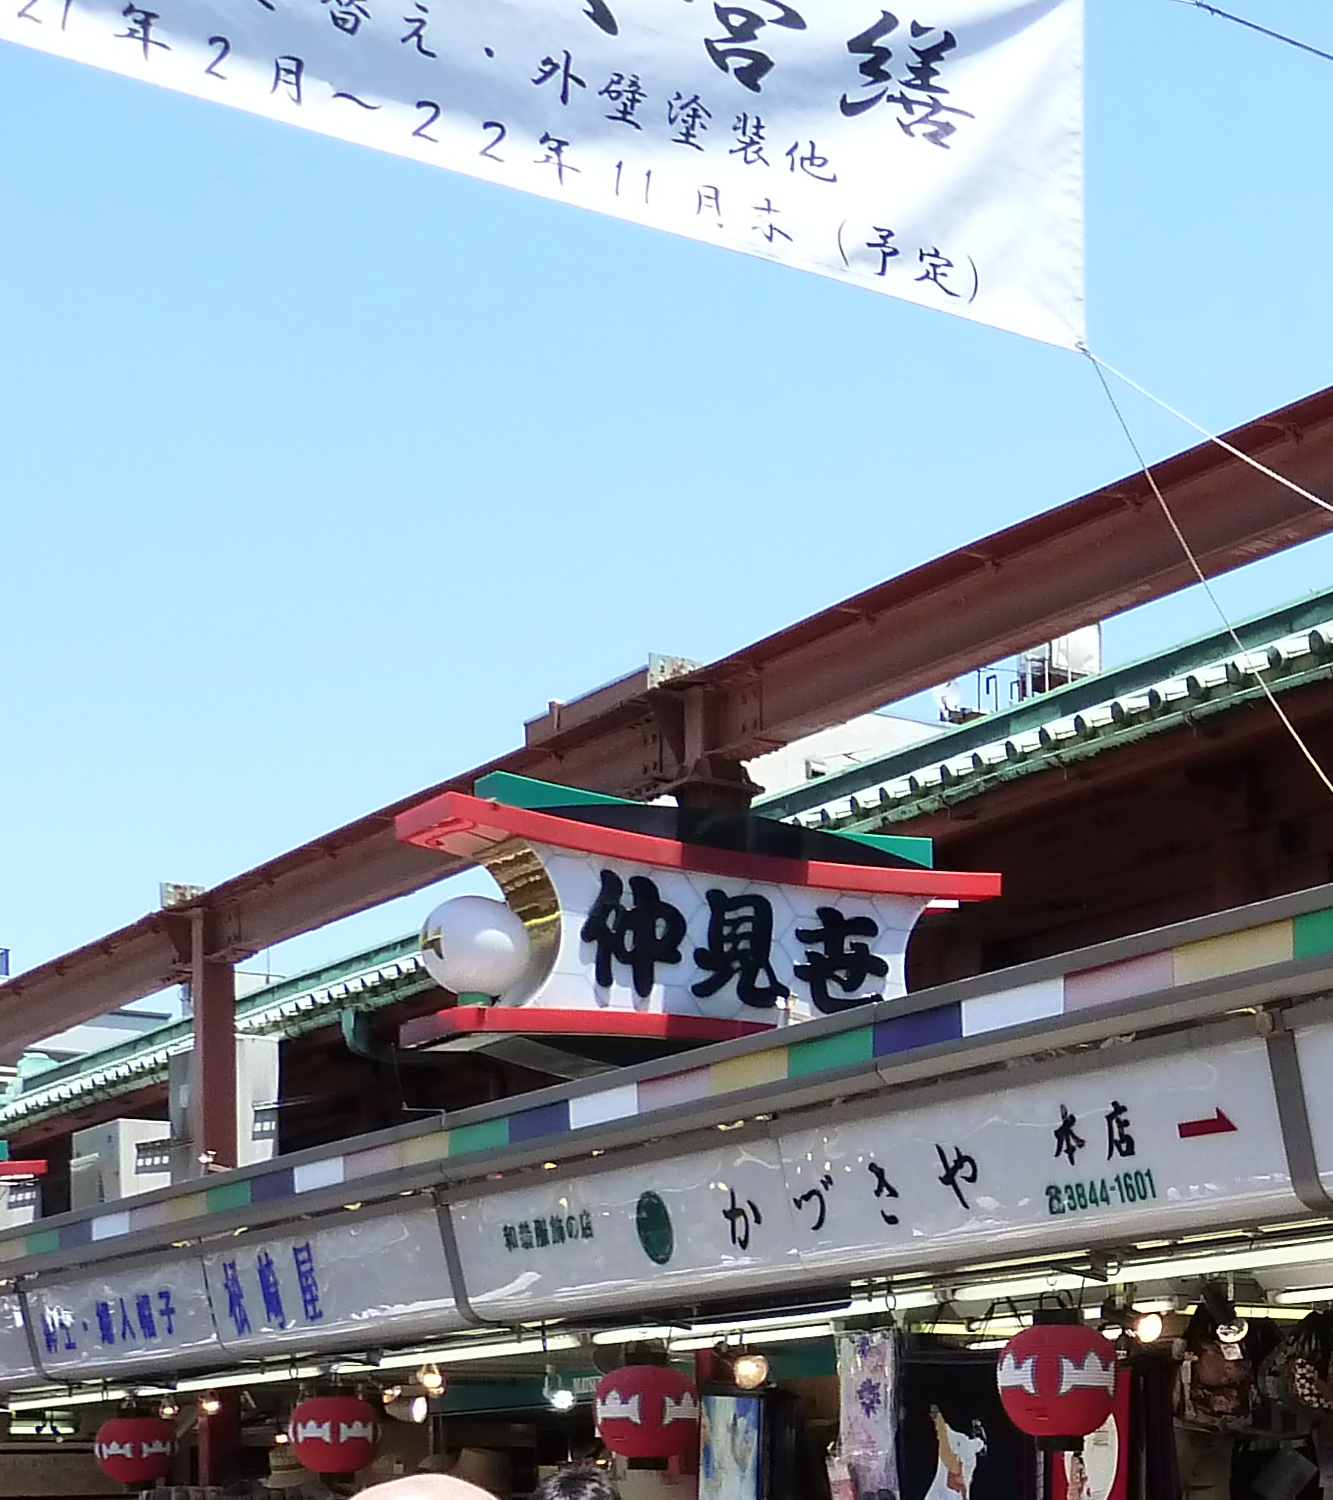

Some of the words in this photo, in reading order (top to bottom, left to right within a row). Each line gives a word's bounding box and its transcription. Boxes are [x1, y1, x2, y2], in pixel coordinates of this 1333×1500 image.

[580, 868, 890, 1014] 仲見世
[1053, 1100, 1136, 1166] 本店
